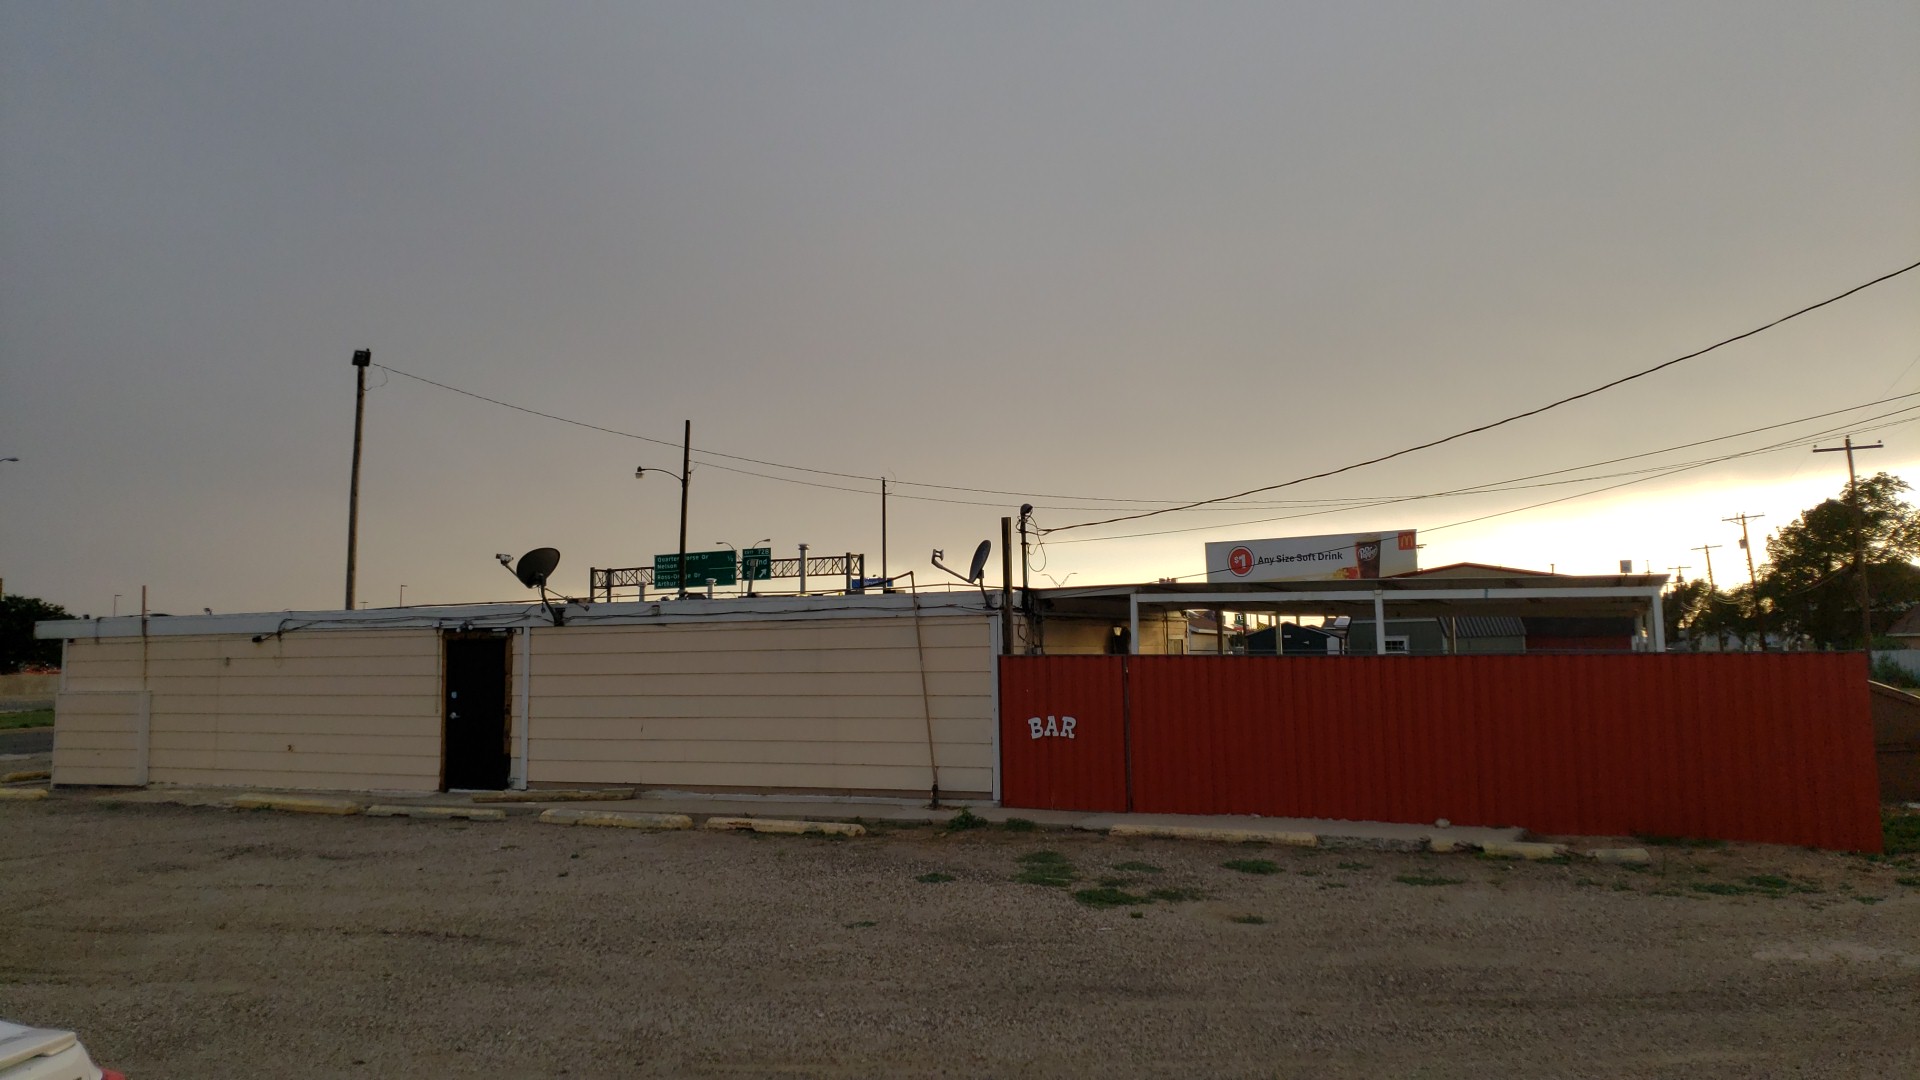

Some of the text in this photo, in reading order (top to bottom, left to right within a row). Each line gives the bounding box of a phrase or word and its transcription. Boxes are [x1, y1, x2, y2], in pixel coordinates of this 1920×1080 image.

[1257, 551, 1344, 565] Any Size Soft Drink
[1028, 715, 1077, 739] BAR
